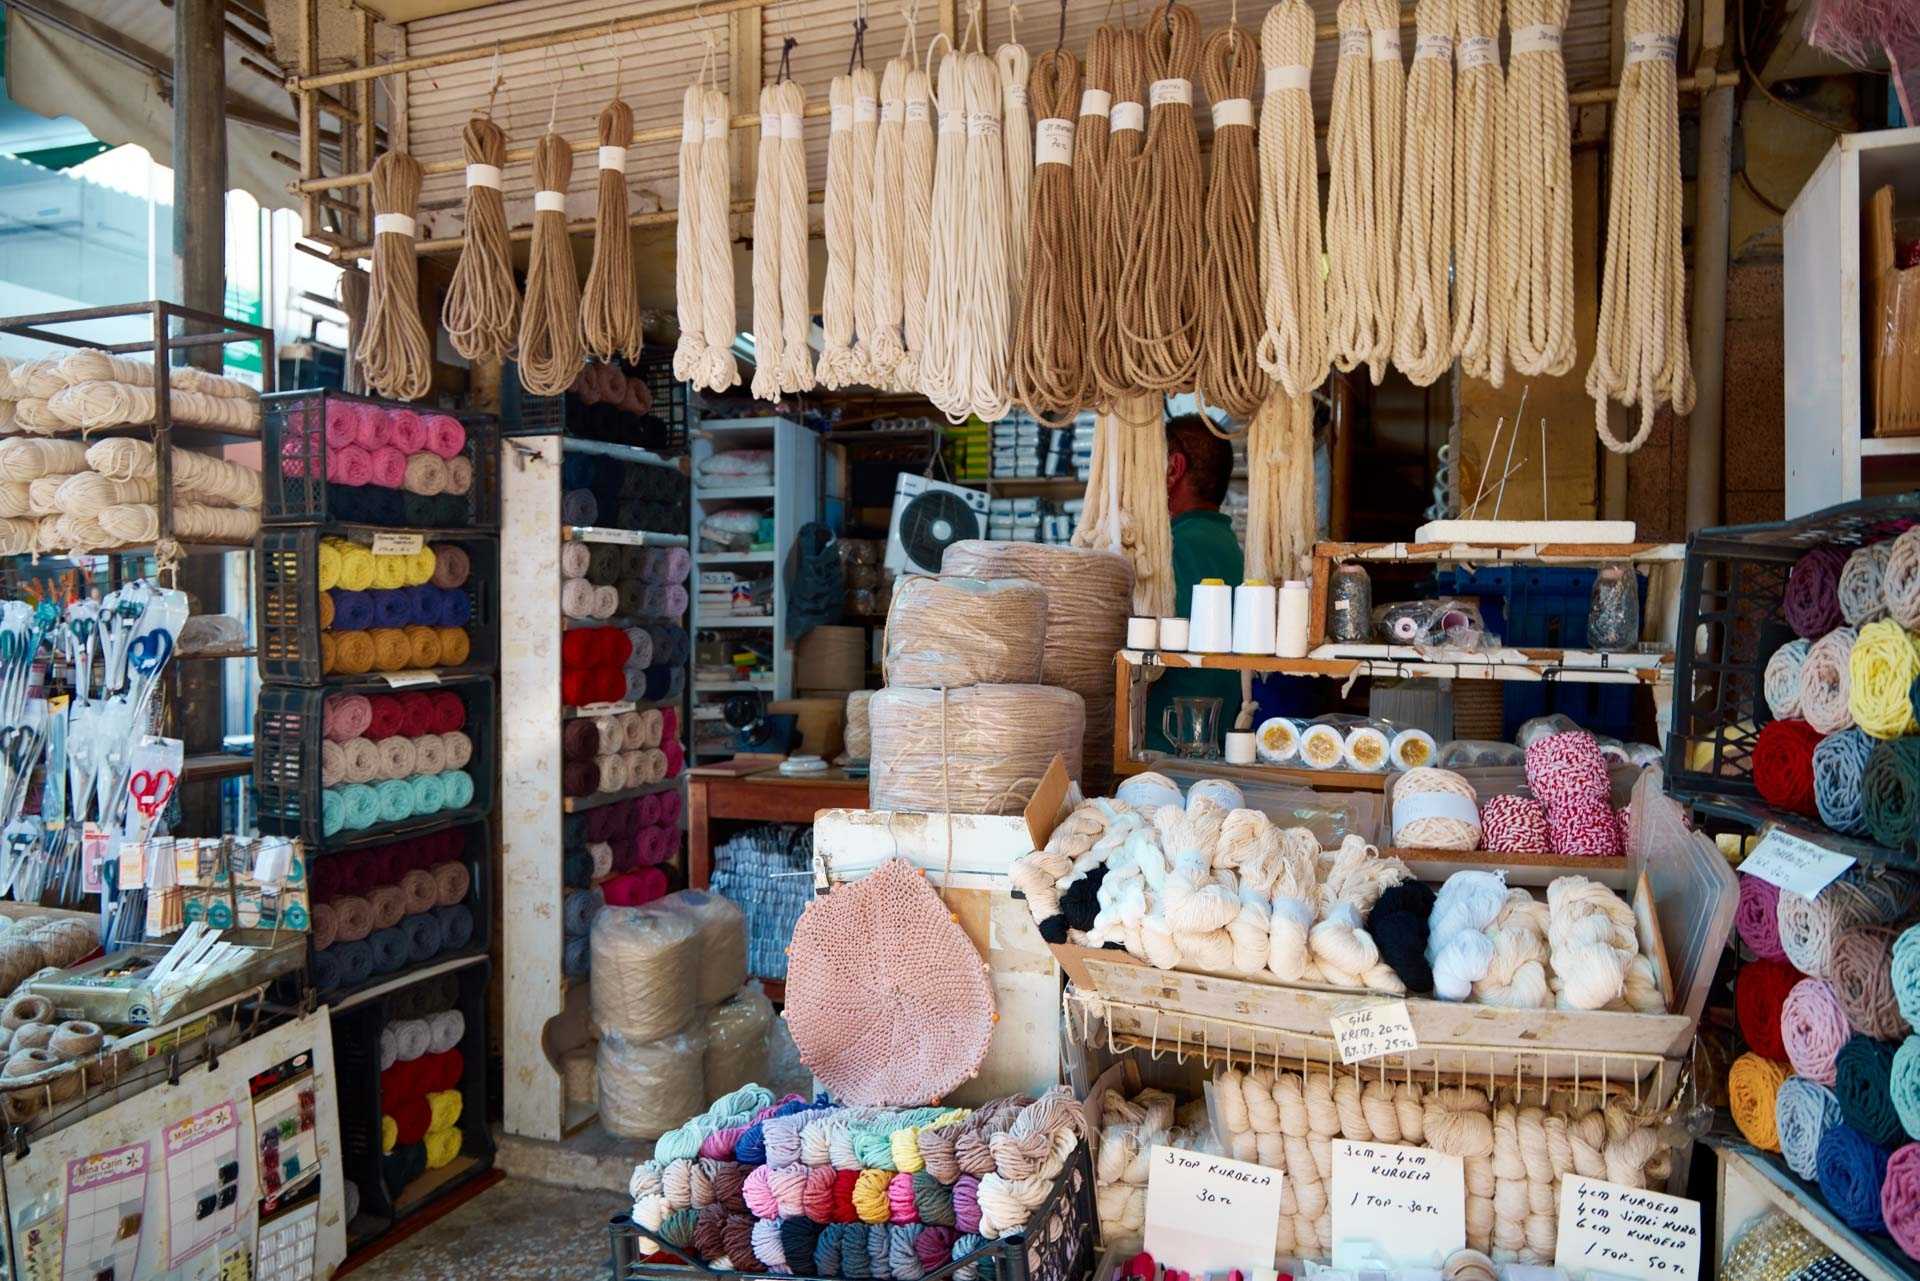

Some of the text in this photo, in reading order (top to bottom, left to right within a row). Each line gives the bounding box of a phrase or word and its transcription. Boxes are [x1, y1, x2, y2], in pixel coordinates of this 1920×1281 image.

[1179, 1158, 1200, 1169] TOP
[1367, 1195, 1392, 1207] TOP
[1619, 1193, 1679, 1215] KURDELA
[1627, 1230, 1686, 1249] KURDELA
